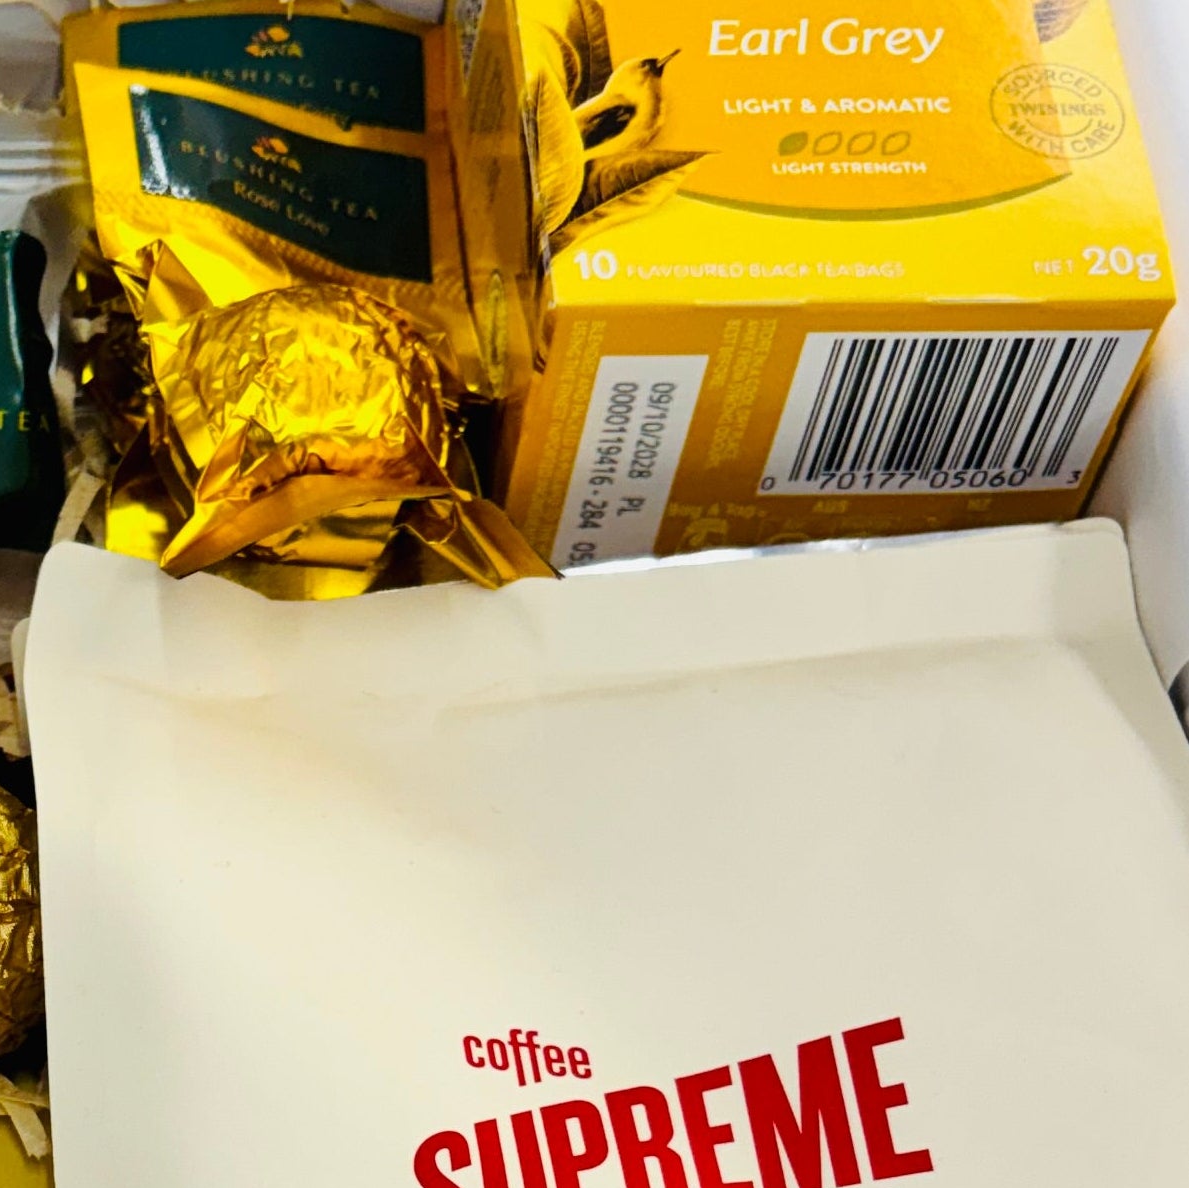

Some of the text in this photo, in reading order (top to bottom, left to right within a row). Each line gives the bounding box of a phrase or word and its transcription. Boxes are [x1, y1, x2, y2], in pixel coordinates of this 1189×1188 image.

[708, 17, 945, 63] Earl Grey
[333, 78, 380, 98] TEA
[1003, 68, 1102, 98] SOURCED
[723, 96, 951, 115] LIGHT & AROMATIC
[1009, 103, 1106, 116] TWININGS
[1008, 120, 1115, 154] WITH CARE
[180, 140, 380, 222] BLUSHING TEA
[772, 161, 927, 176] LIGHT STRENGTH
[573, 249, 618, 281] 10
[626, 262, 744, 280] FLAVOURED
[749, 261, 808, 279] BLACK
[1034, 246, 1162, 282] NET 20g
[616, 382, 677, 517] 09/10/2028 PL
[761, 467, 1080, 490] 0 70177 05060 3
[462, 1028, 592, 1087] coffee
